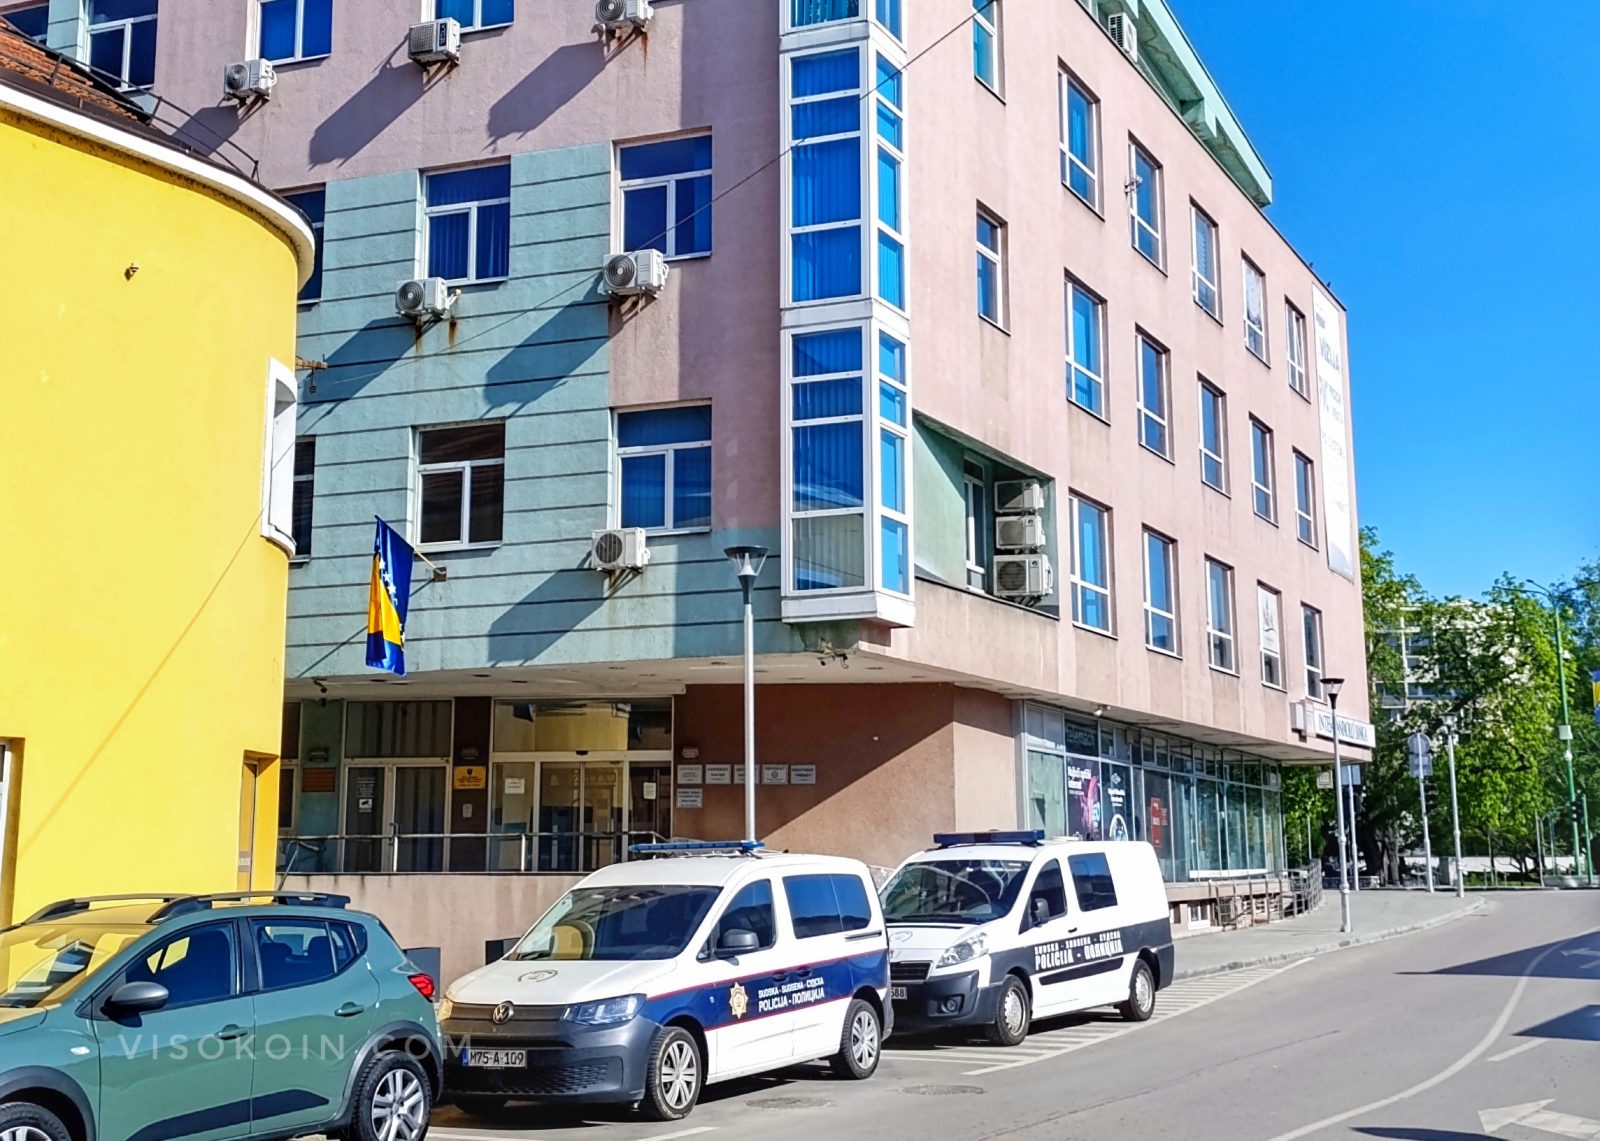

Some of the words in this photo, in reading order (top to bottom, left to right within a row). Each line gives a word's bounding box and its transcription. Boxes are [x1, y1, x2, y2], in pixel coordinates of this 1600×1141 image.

[1034, 942, 1059, 955] SUDSKA
[1034, 948, 1074, 971] POLICIJA
[758, 995, 788, 1012] POLICIJA
[469, 1051, 524, 1065] M75-A-109
